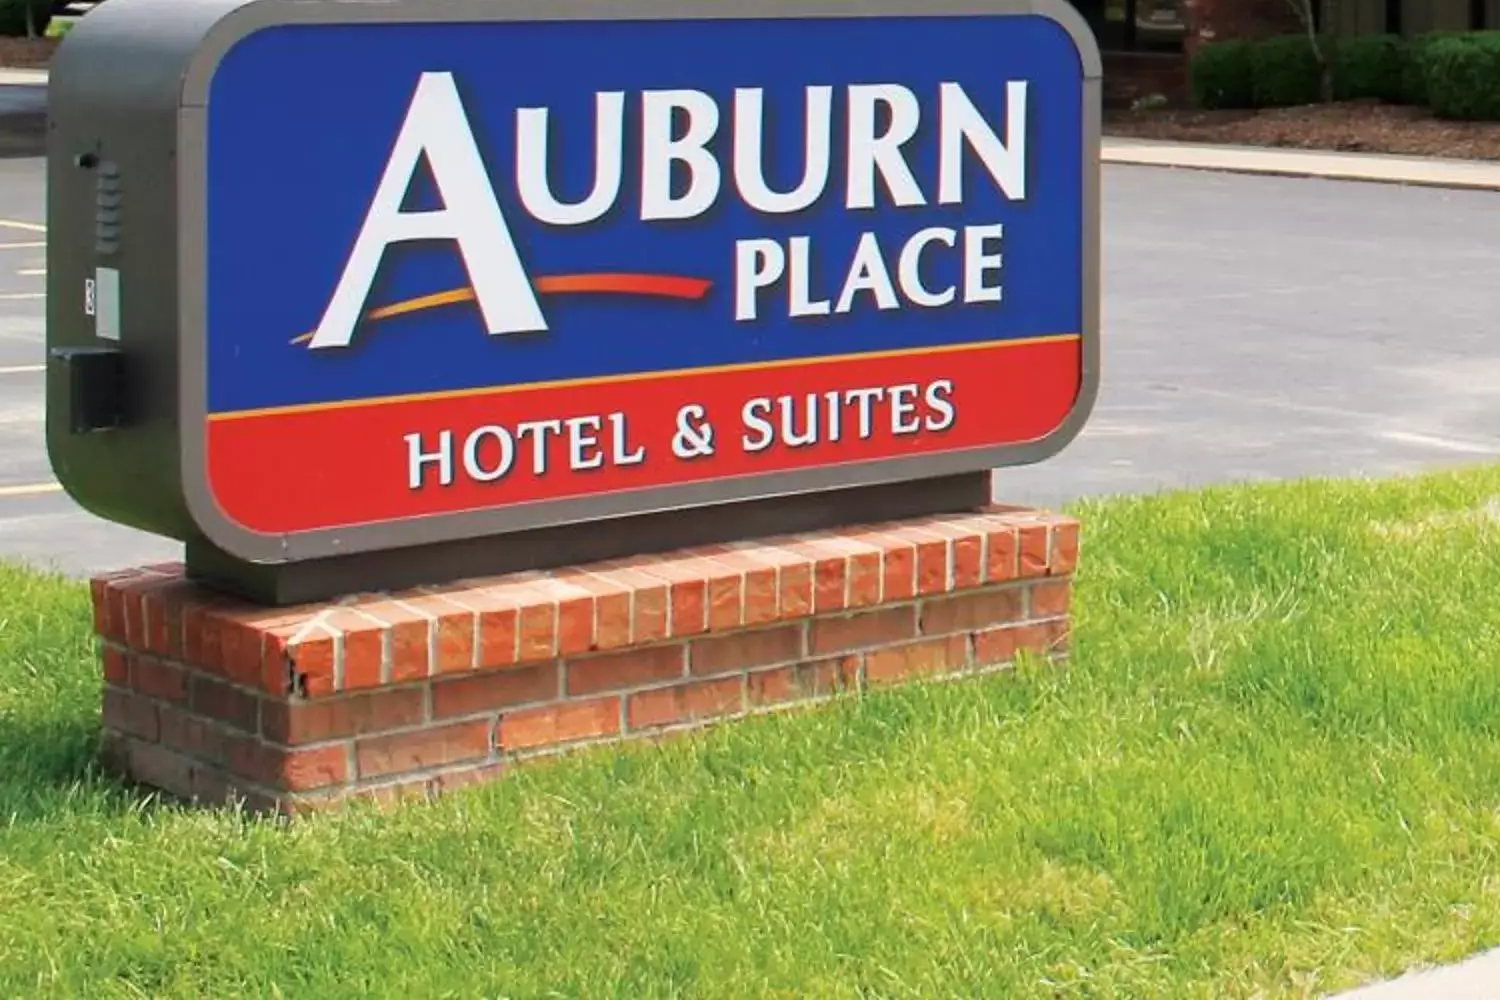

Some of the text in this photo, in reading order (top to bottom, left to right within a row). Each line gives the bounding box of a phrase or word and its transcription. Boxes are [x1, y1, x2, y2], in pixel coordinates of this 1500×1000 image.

[735, 224, 1003, 321] PLACE
[404, 380, 955, 488] HOTEL & SUITES
